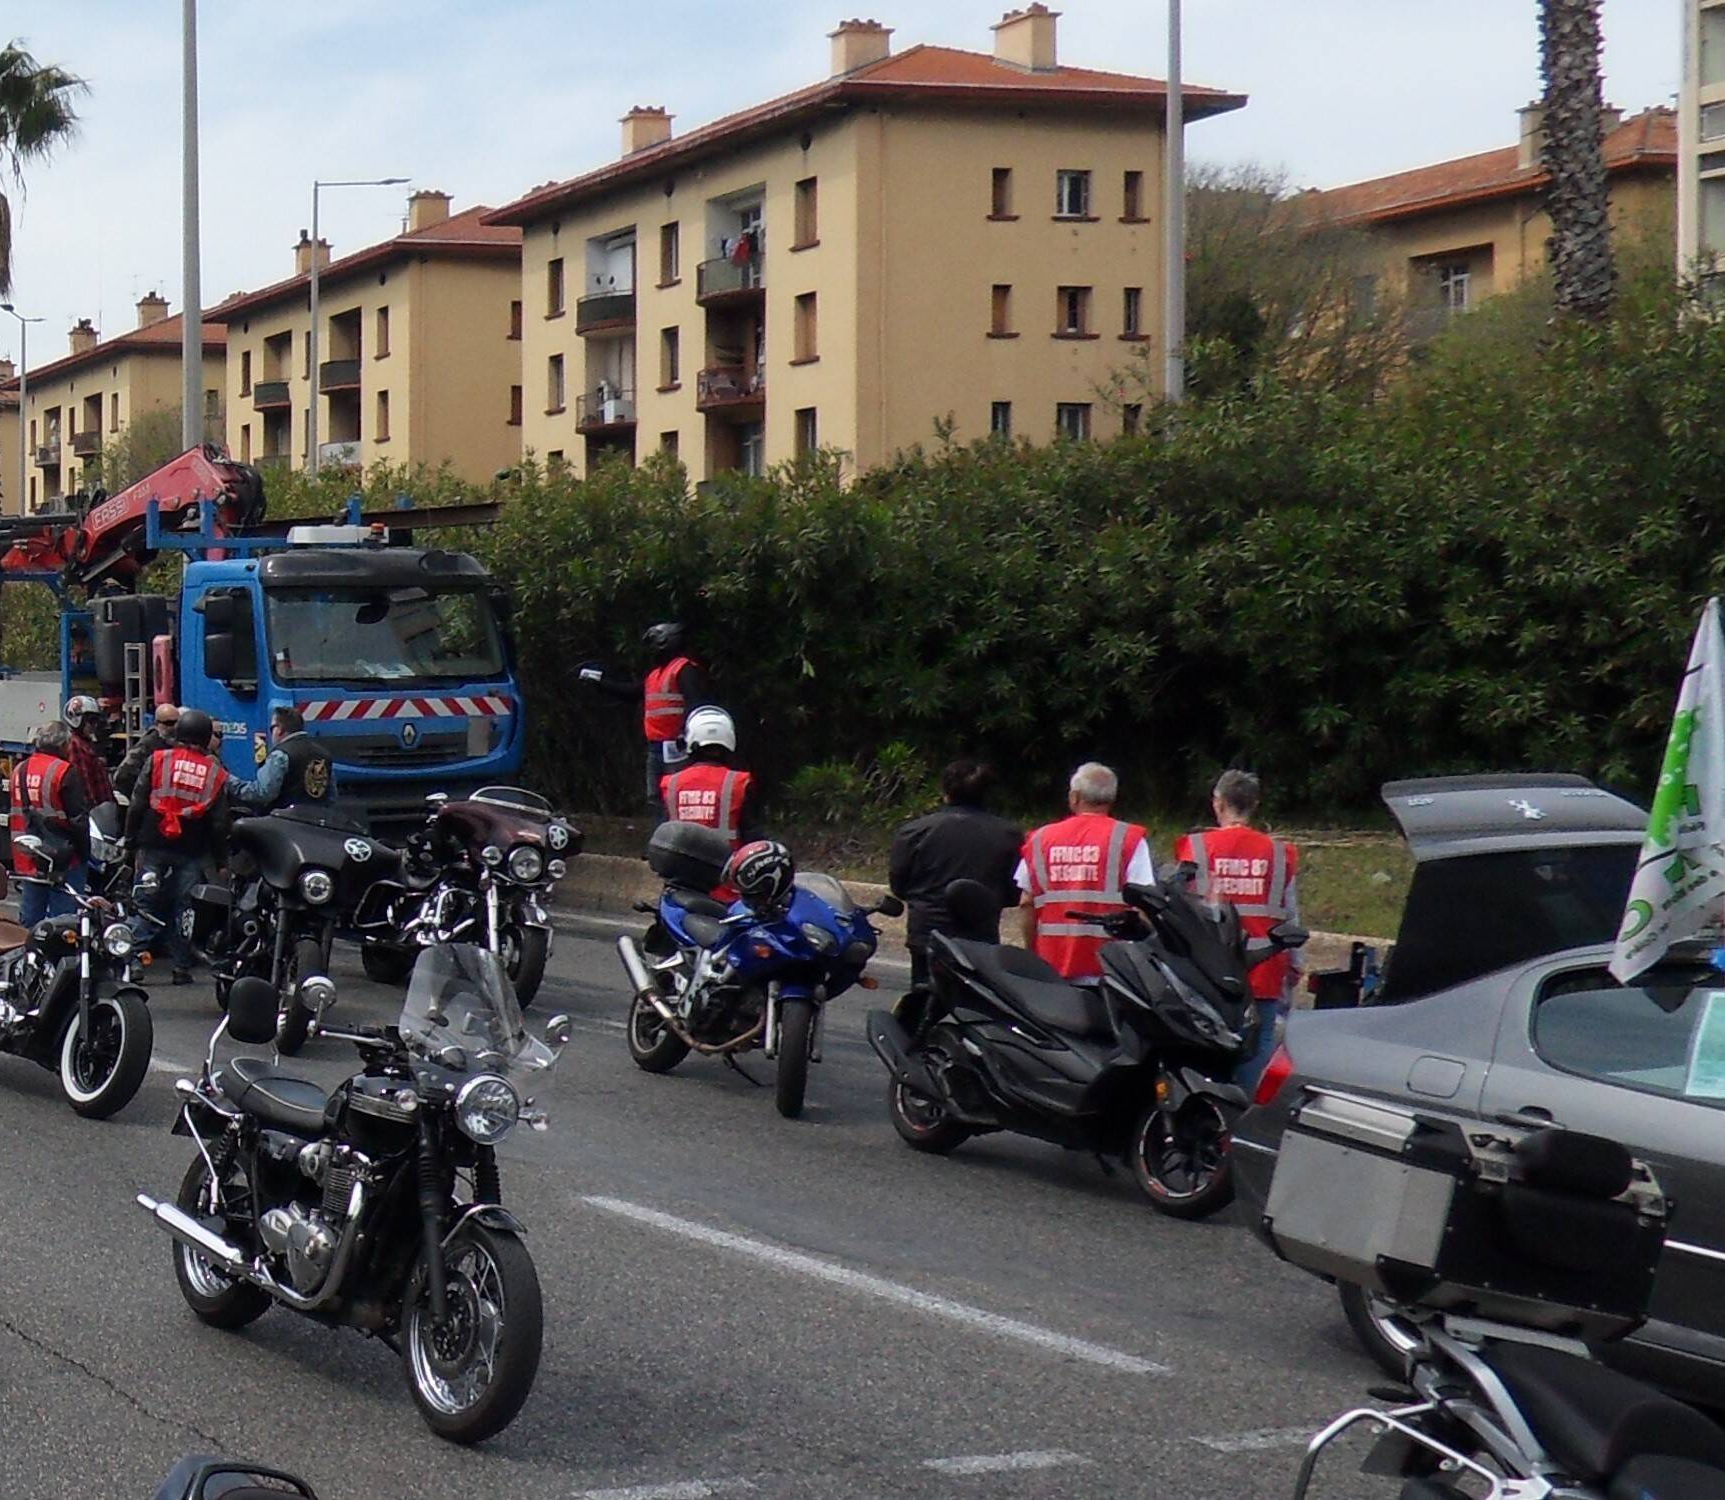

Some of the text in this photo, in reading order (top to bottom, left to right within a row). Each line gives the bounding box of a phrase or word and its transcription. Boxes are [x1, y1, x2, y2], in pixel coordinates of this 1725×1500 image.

[678, 790, 717, 804] FFMC 83
[1049, 845, 1100, 863] FFMC 83
[1215, 858, 1250, 876] FFMC
